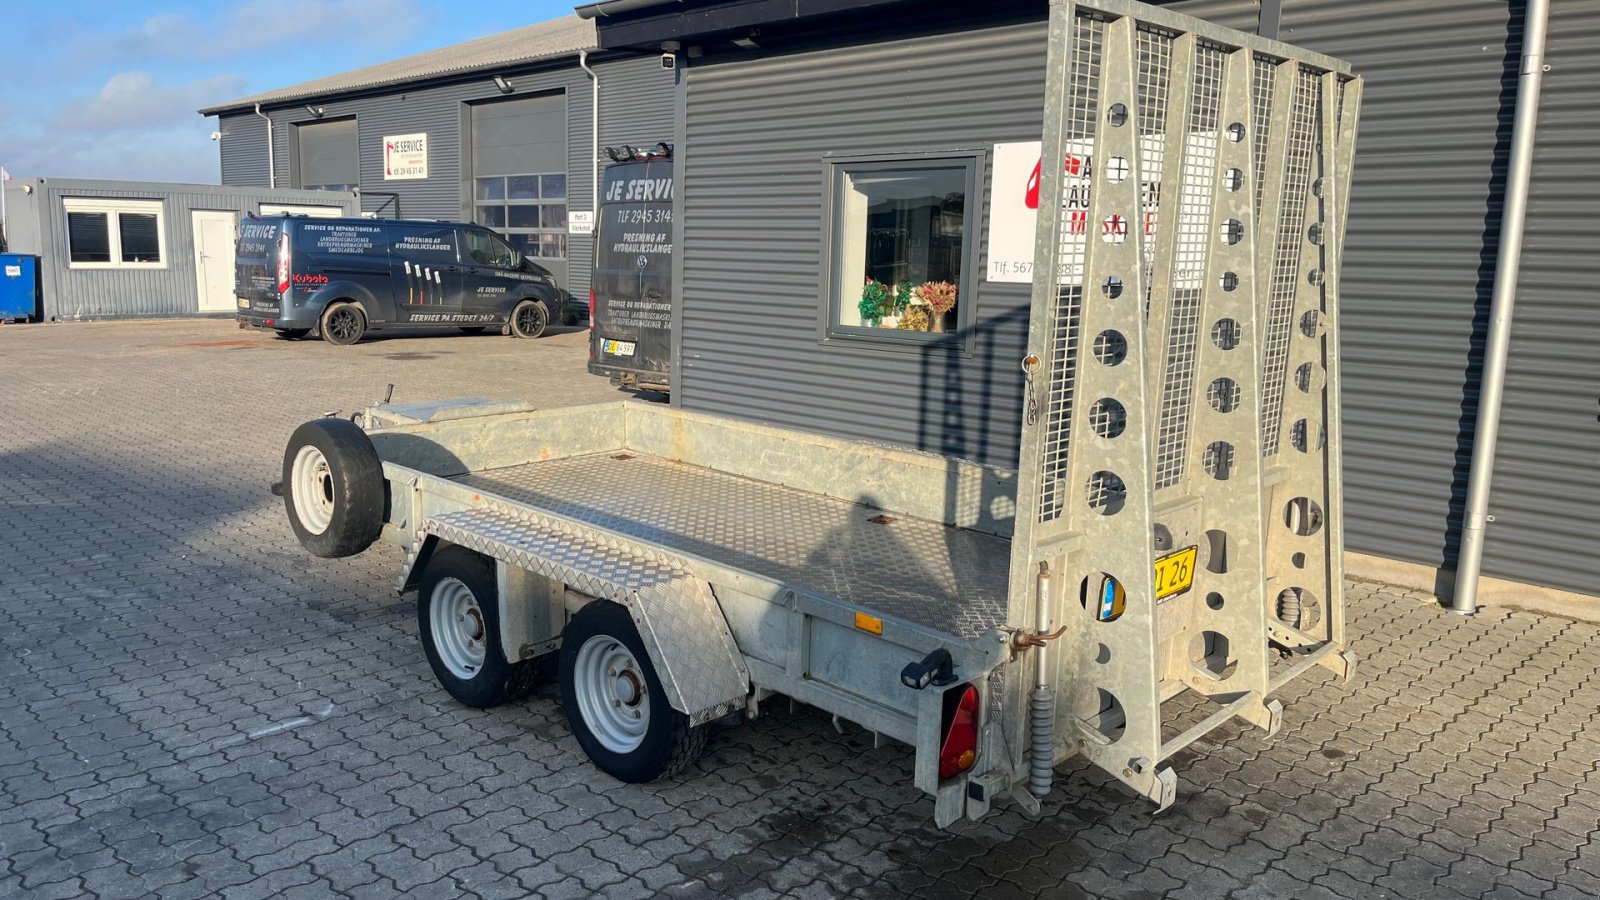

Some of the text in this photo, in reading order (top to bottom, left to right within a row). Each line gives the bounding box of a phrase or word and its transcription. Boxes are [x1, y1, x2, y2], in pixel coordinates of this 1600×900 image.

[400, 140, 423, 152] SERVICE
[606, 178, 673, 200] JE SERVI
[617, 210, 630, 223] TLF
[631, 209, 653, 223] 2945
[244, 224, 276, 239] SERVICE
[623, 232, 666, 242] PRESNING AF
[404, 236, 431, 244] PRESNING
[994, 261, 1009, 275] Tlf.
[293, 274, 328, 284] Kubota
[608, 300, 626, 308] SERVICE
[410, 314, 440, 322] SERVICE
[441, 313, 450, 321] PÅ
[1169, 556, 1188, 587] 26
